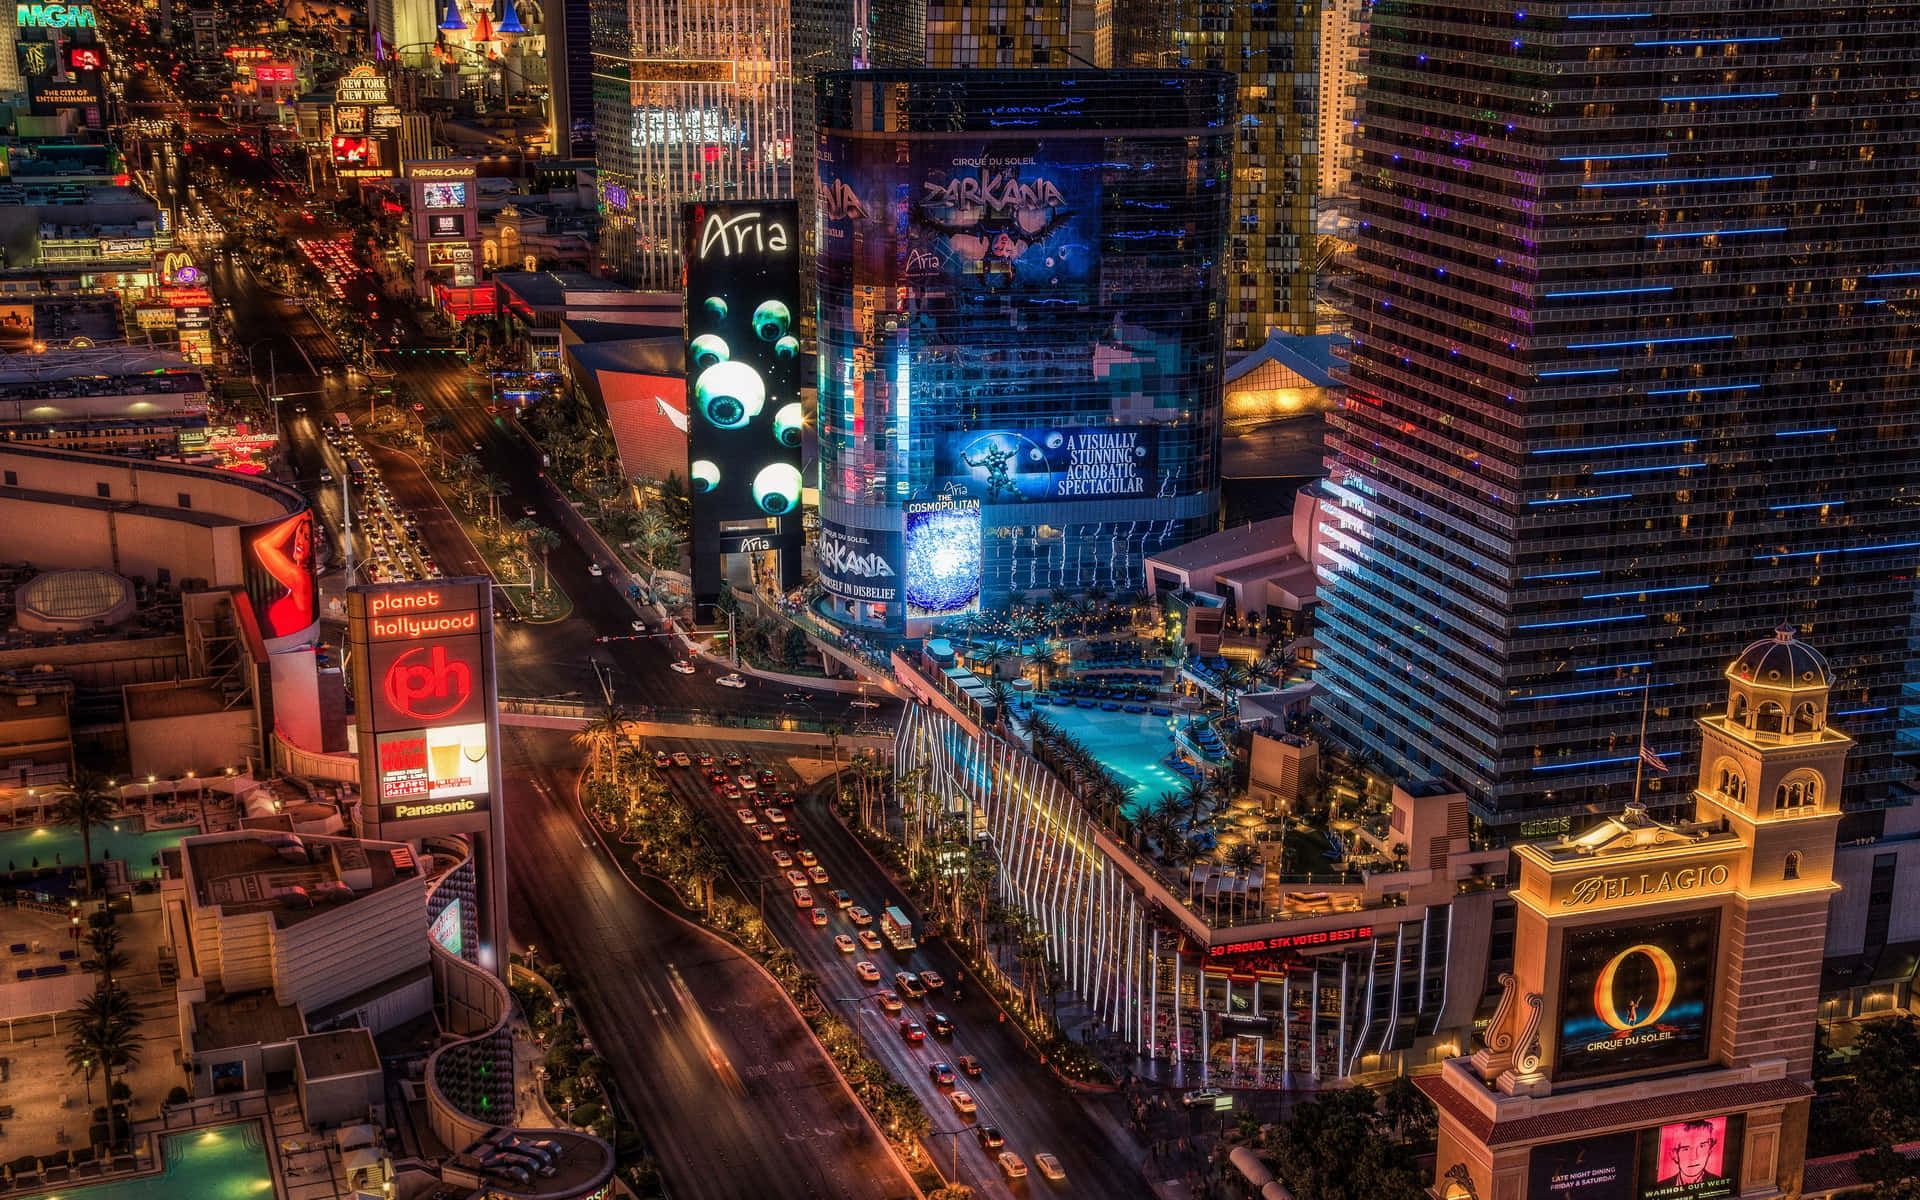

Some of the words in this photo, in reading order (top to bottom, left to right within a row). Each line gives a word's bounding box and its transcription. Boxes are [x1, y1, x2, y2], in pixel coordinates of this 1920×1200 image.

[16, 4, 97, 28] MGM
[342, 79, 361, 89] NEW
[363, 79, 386, 89] YORK
[342, 90, 362, 101] NEW
[364, 90, 387, 101] YORK
[952, 157, 987, 167] CIRQUE
[989, 157, 1003, 166] DU
[1005, 156, 1037, 166] SOLEIL
[411, 168, 444, 176] Monte
[444, 168, 475, 176] Carlo
[920, 169, 1066, 212] ZARKANA
[700, 212, 788, 259] Aria
[455, 250, 472, 258] CVS
[905, 248, 940, 273] Aria
[1066, 436, 1076, 450] A
[1078, 433, 1138, 449] VISUALLY
[1070, 448, 1133, 465] STUNNING
[1066, 463, 1137, 481] ACROBATIC
[943, 481, 968, 497] Aria
[1057, 477, 1145, 496] SPECTACULAR
[908, 499, 980, 513] COSMOPOLITAN
[937, 494, 953, 502] THE
[740, 537, 769, 552] Aria
[847, 535, 870, 545] SOLEIL
[844, 583, 852, 595] IN
[853, 585, 896, 600] DISBELIEF
[372, 591, 440, 615] planet
[373, 612, 475, 636] hollywood
[394, 646, 471, 713] ph
[380, 738, 426, 754] HAPPY
[395, 799, 475, 818] Panasonic
[1210, 946, 1225, 957] SO
[1226, 941, 1267, 954] PROUD.
[1269, 936, 1291, 949] STK
[1292, 932, 1327, 946] VOTED
[1329, 928, 1357, 942] BEST
[1594, 944, 1677, 1031] O
[1587, 1039, 1623, 1052] CIRQUE
[1625, 1036, 1639, 1045] DU
[1640, 1031, 1673, 1043] SOLEIL
[1550, 1181, 1574, 1190] FRIDAY
[1581, 1174, 1616, 1185] SATURDAY
[1551, 1175, 1569, 1183] LATE
[1570, 1171, 1591, 1179] NIGHT
[1591, 1166, 1616, 1175] DINING
[1645, 1186, 1685, 1198] WARHOL
[1688, 1182, 1705, 1190] OUT
[1707, 1178, 1732, 1187] WEST
